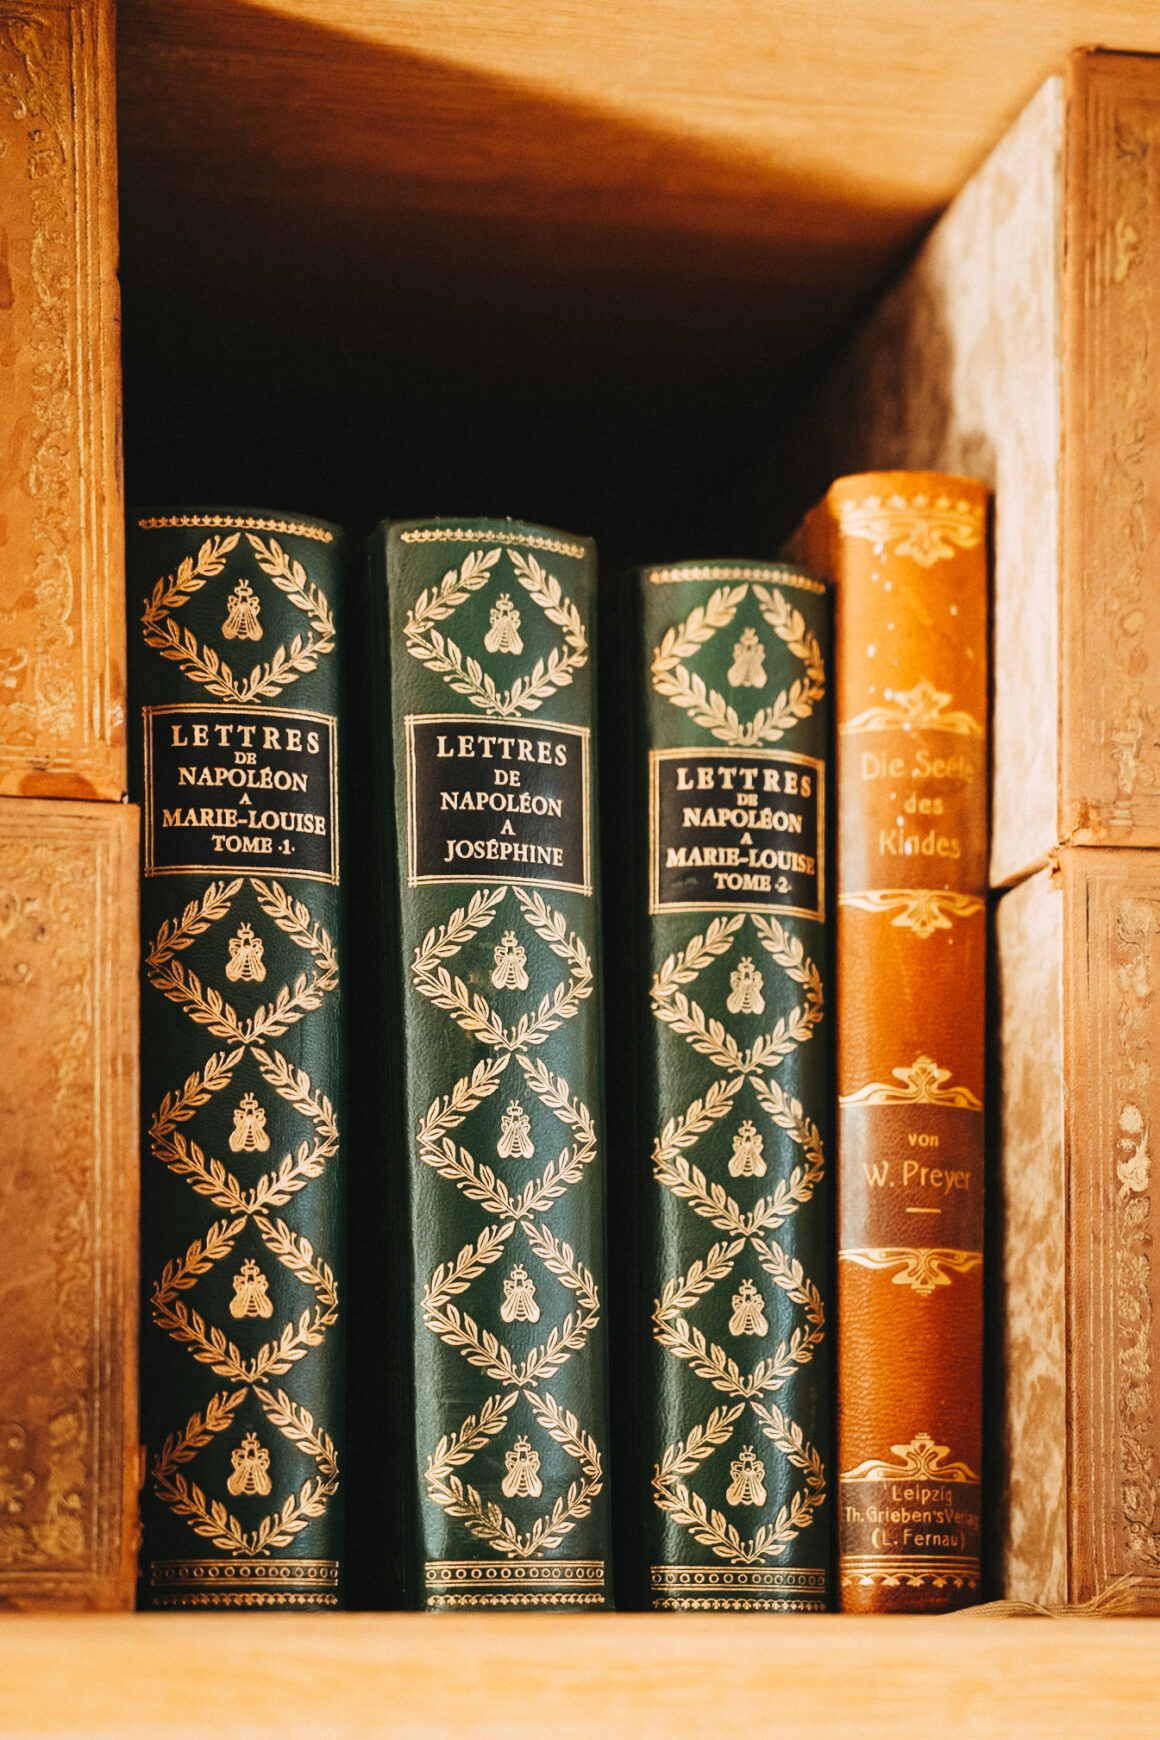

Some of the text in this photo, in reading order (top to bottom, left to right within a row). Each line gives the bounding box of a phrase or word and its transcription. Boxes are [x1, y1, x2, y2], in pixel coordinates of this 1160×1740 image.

[171, 724, 320, 754] LETTRES
[436, 735, 567, 766] LETTRES
[234, 752, 257, 765] DE
[861, 752, 905, 781] Die
[178, 766, 308, 792] NAPOLÉON
[494, 769, 521, 787] DE
[676, 766, 812, 798] LETTRES
[239, 792, 252, 805] A
[440, 791, 562, 818] NAPOLÉON
[736, 793, 758, 807] DE
[904, 792, 944, 815] des
[162, 808, 326, 836] MARIE-LOUISE
[500, 819, 516, 836] A
[682, 807, 803, 834] NAPOLÉON
[211, 834, 273, 853] TOME
[740, 832, 753, 845] A
[879, 829, 961, 859] Kindes
[444, 838, 564, 867] JOSÉPHINE
[666, 847, 815, 875] MARIE-LOUISE
[713, 872, 772, 892] TOME
[908, 1133, 939, 1147] von
[863, 1160, 971, 1195] W. Preyer
[892, 1485, 952, 1506] Leipzig
[845, 1506, 865, 1523] Th.
[872, 1528, 965, 1551] (L. Fernau)
